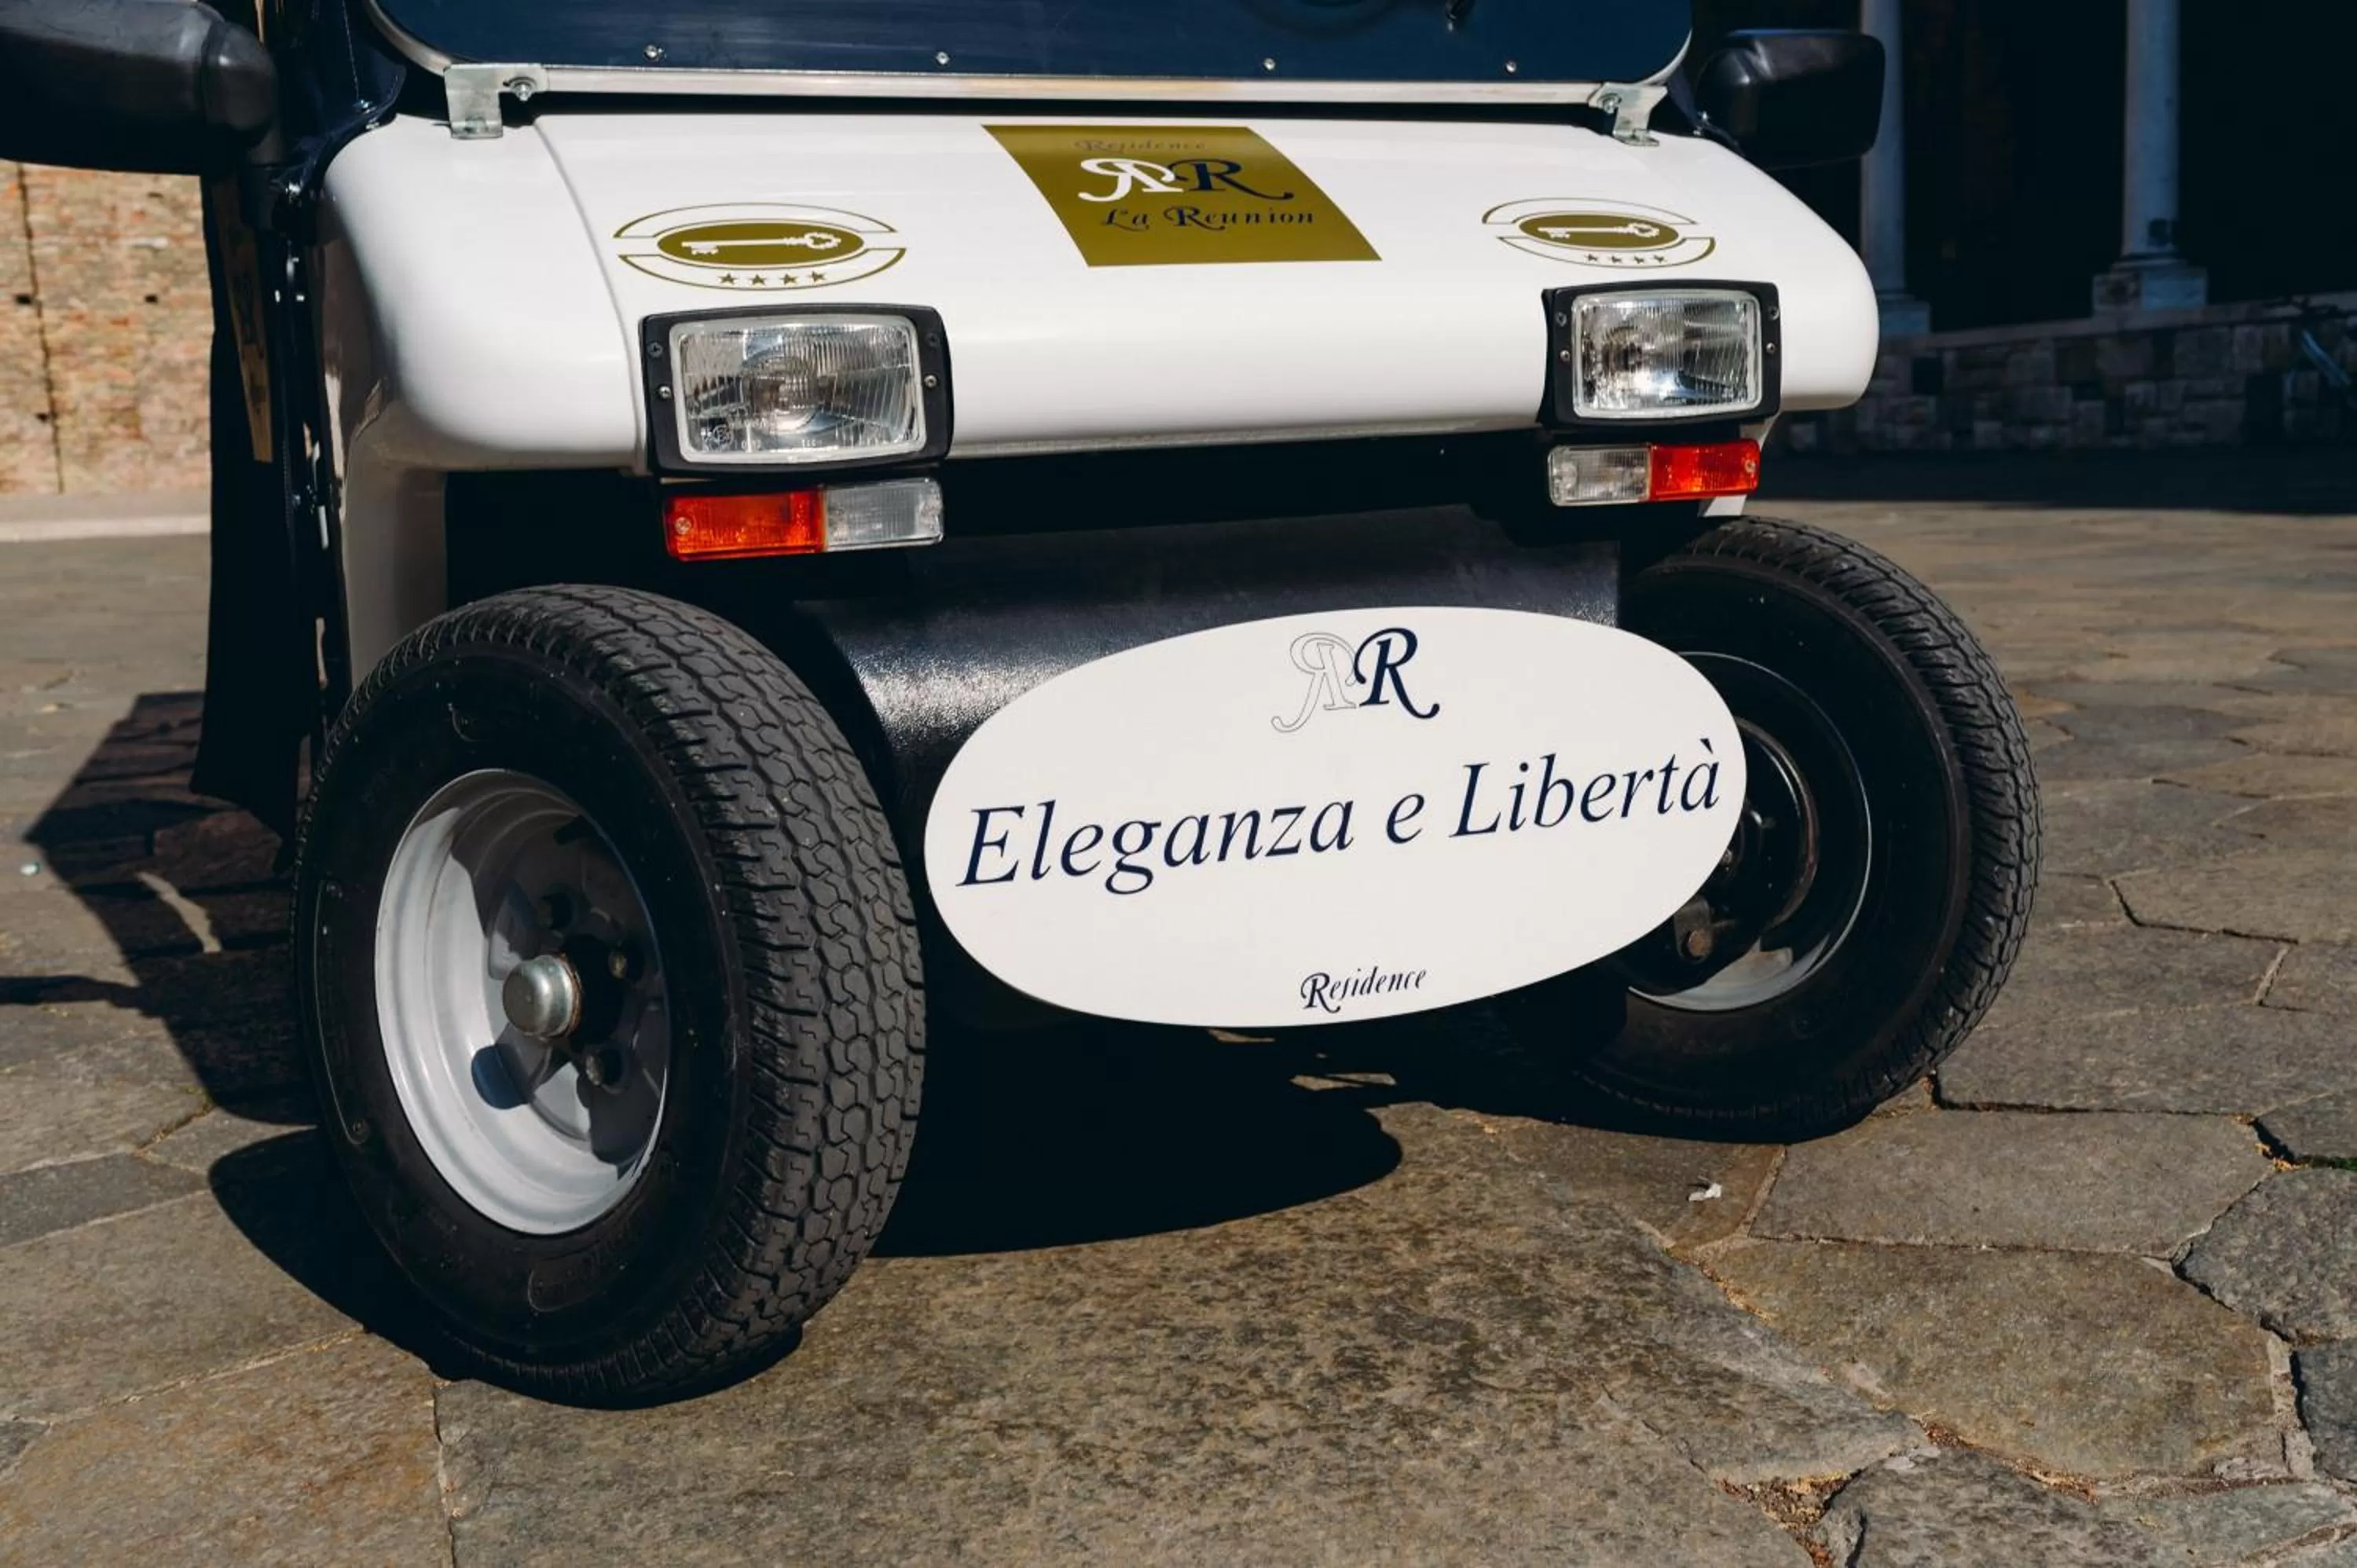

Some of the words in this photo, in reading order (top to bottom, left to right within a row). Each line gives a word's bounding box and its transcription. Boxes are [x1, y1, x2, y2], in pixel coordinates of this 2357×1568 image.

[1102, 207, 1150, 232] La
[1162, 205, 1314, 232] Reunion
[955, 799, 1354, 896] Eleganza
[1386, 793, 1425, 844] e
[1449, 738, 1721, 838] Libertà
